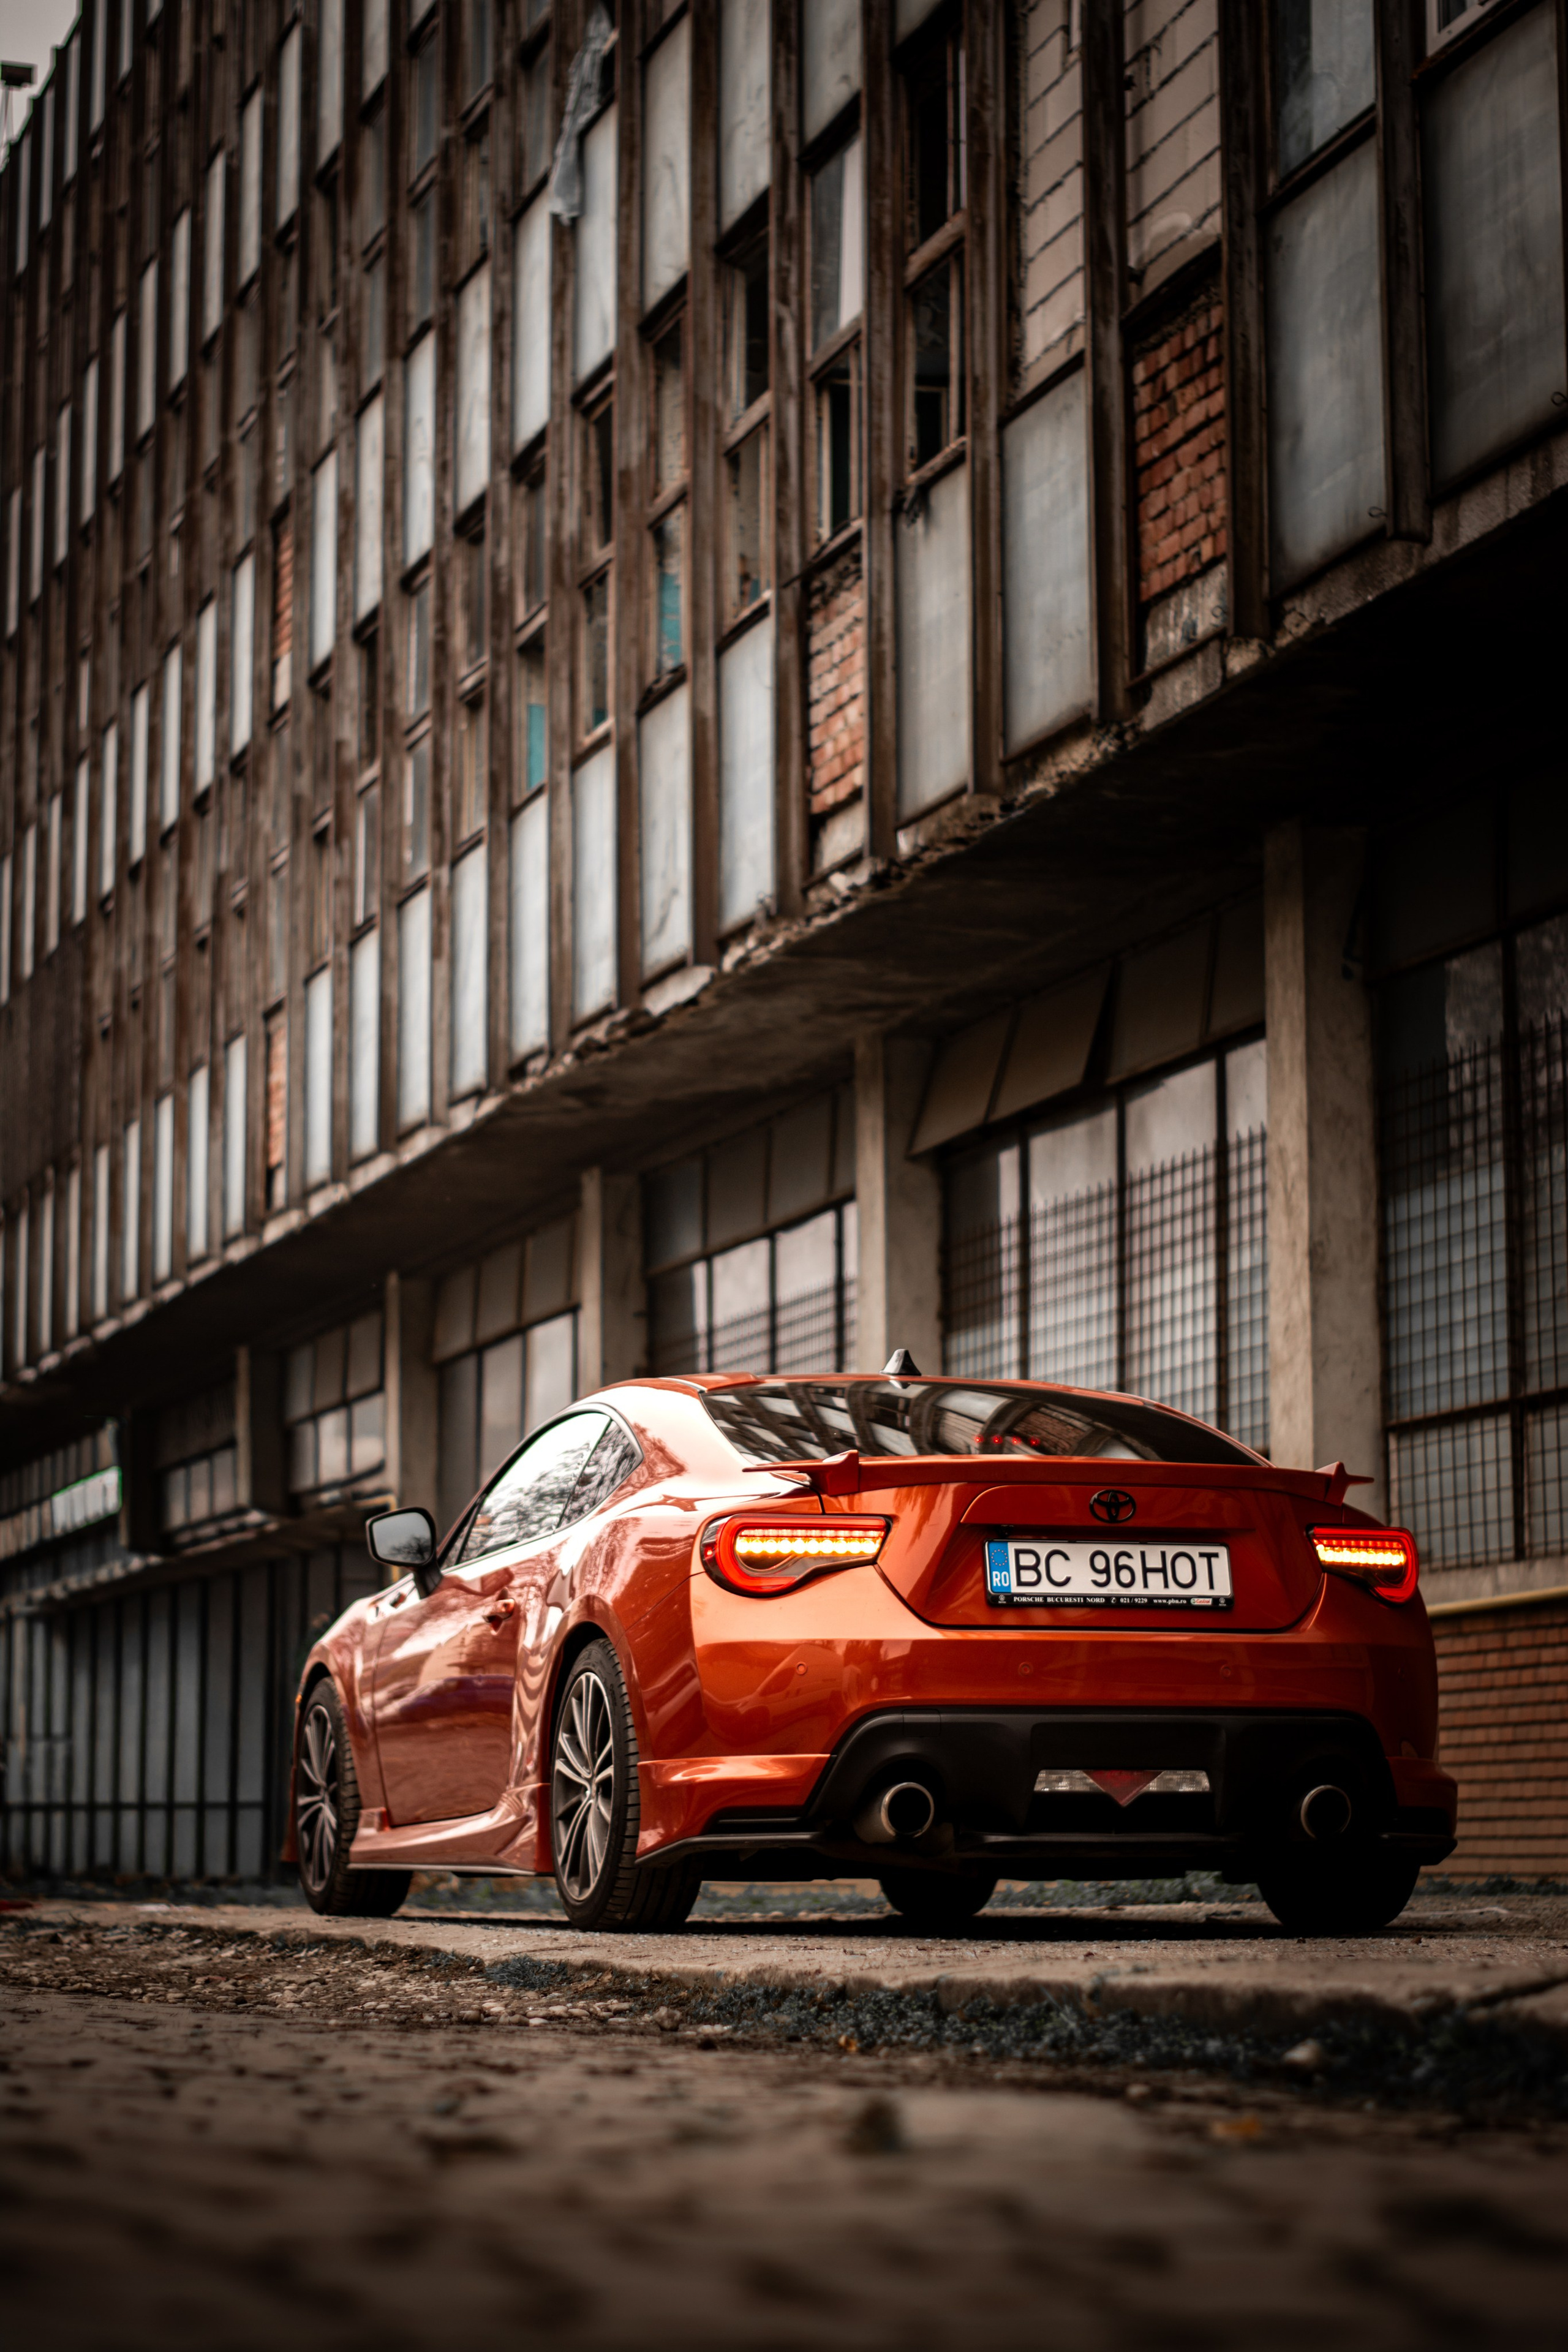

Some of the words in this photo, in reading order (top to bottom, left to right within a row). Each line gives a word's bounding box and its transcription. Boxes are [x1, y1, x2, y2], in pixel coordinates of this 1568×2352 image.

[992, 1571, 1009, 1586] RO
[1013, 1548, 1072, 1587] BC
[1088, 1548, 1219, 1590] 96HOT
